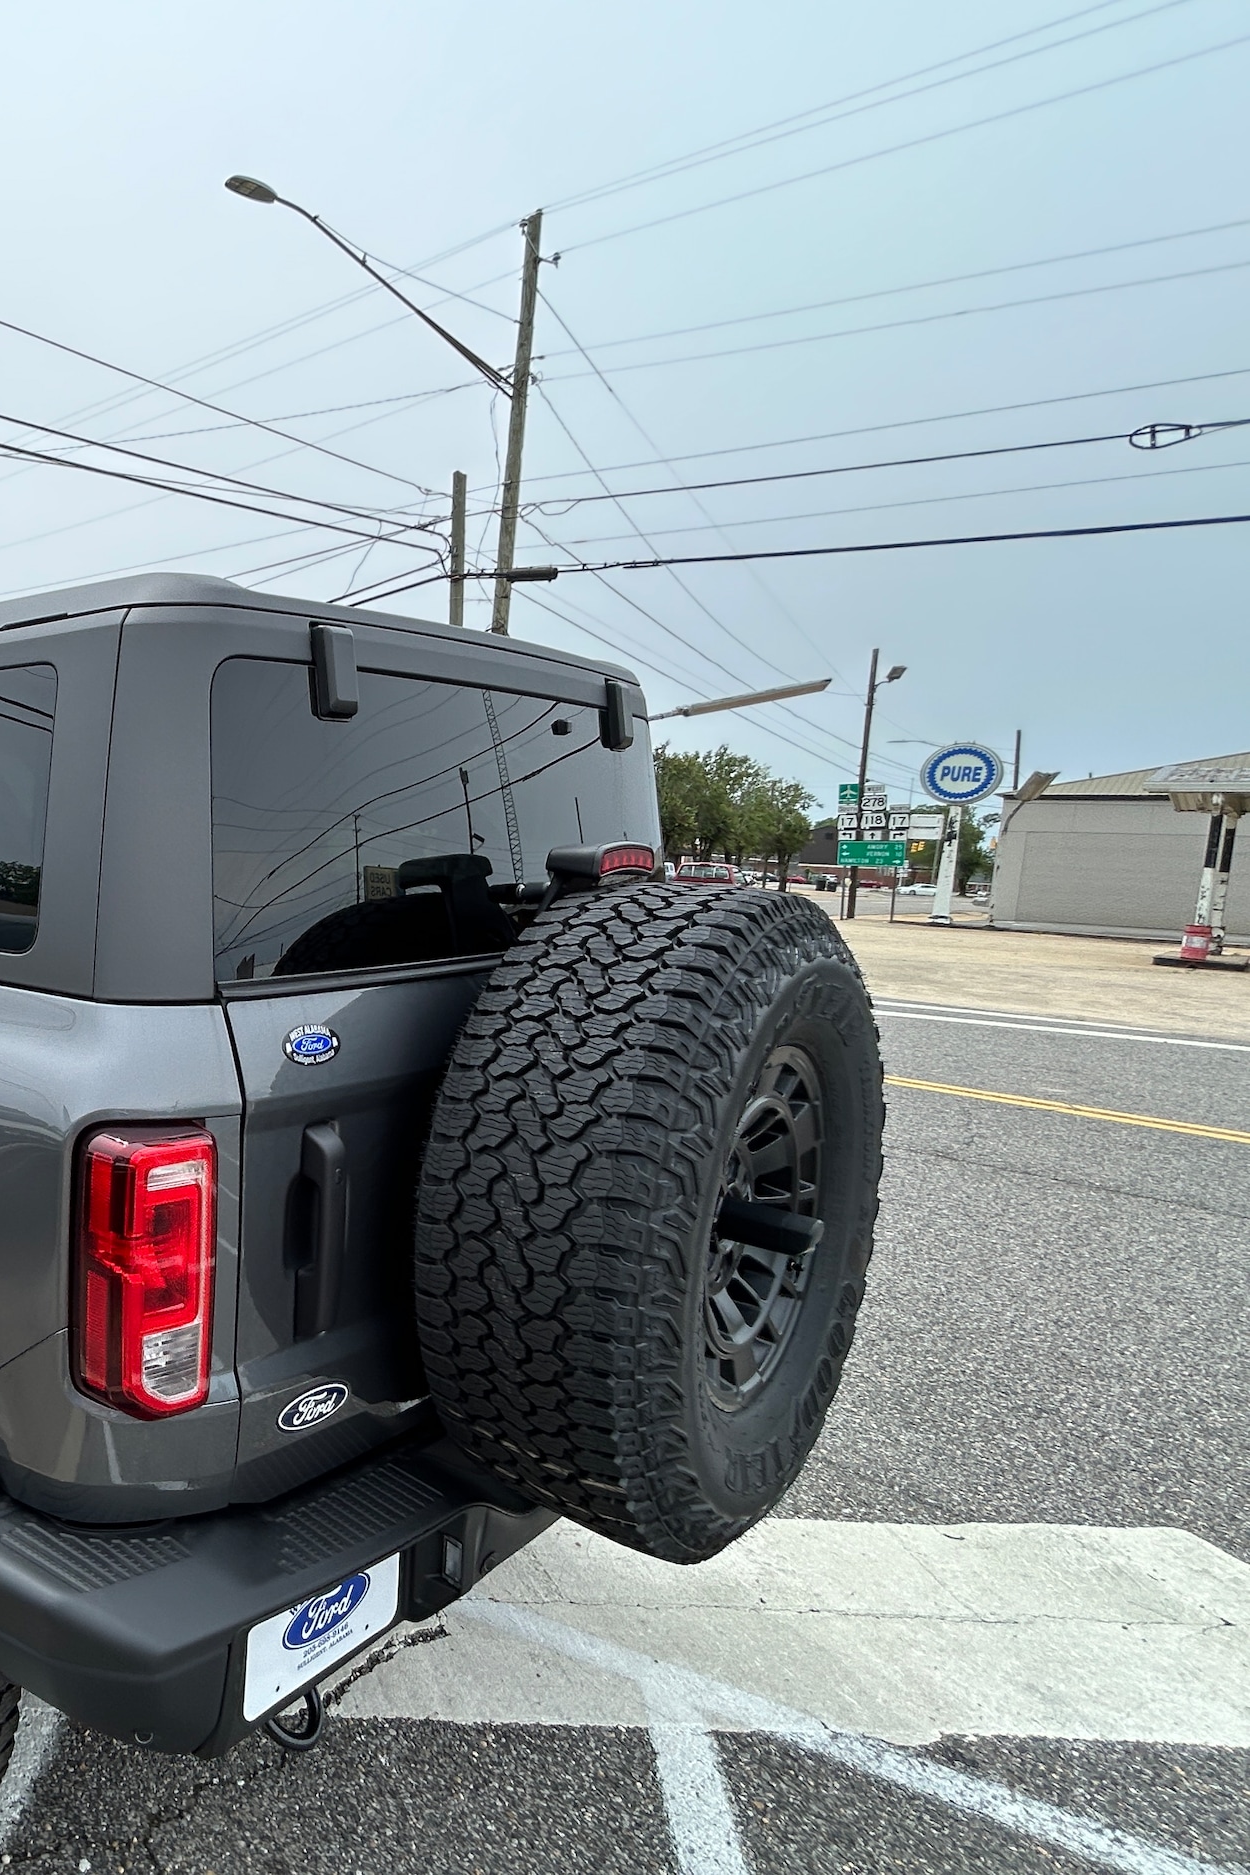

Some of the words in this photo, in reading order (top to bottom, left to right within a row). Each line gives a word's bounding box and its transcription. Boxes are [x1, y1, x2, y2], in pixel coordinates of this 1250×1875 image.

[940, 765, 983, 783] PURE
[862, 797, 885, 807] 278
[841, 817, 854, 826] 17
[864, 816, 883, 825] 118
[892, 816, 906, 826] 17
[289, 1026, 304, 1041] WEST
[304, 1025, 331, 1037] ALABAMA
[300, 1037, 324, 1051] Ford
[293, 1391, 338, 1426] Ford
[302, 1584, 354, 1639] Ford
